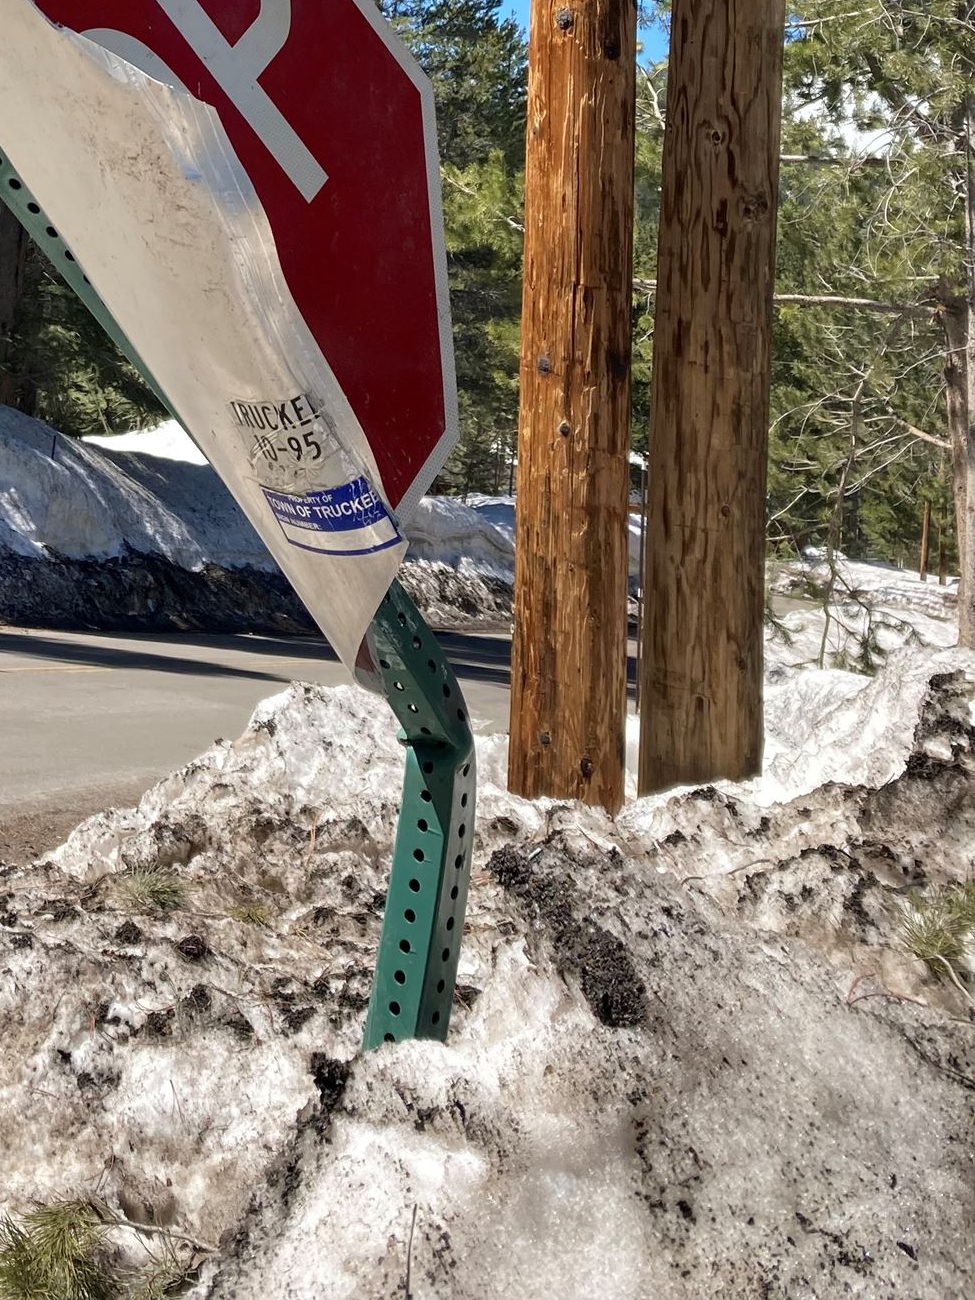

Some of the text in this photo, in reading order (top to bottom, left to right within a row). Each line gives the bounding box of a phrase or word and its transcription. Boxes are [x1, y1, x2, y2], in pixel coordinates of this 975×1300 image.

[321, 493, 333, 503] OF
[266, 495, 297, 516] TOWN
[296, 504, 312, 518] OF
